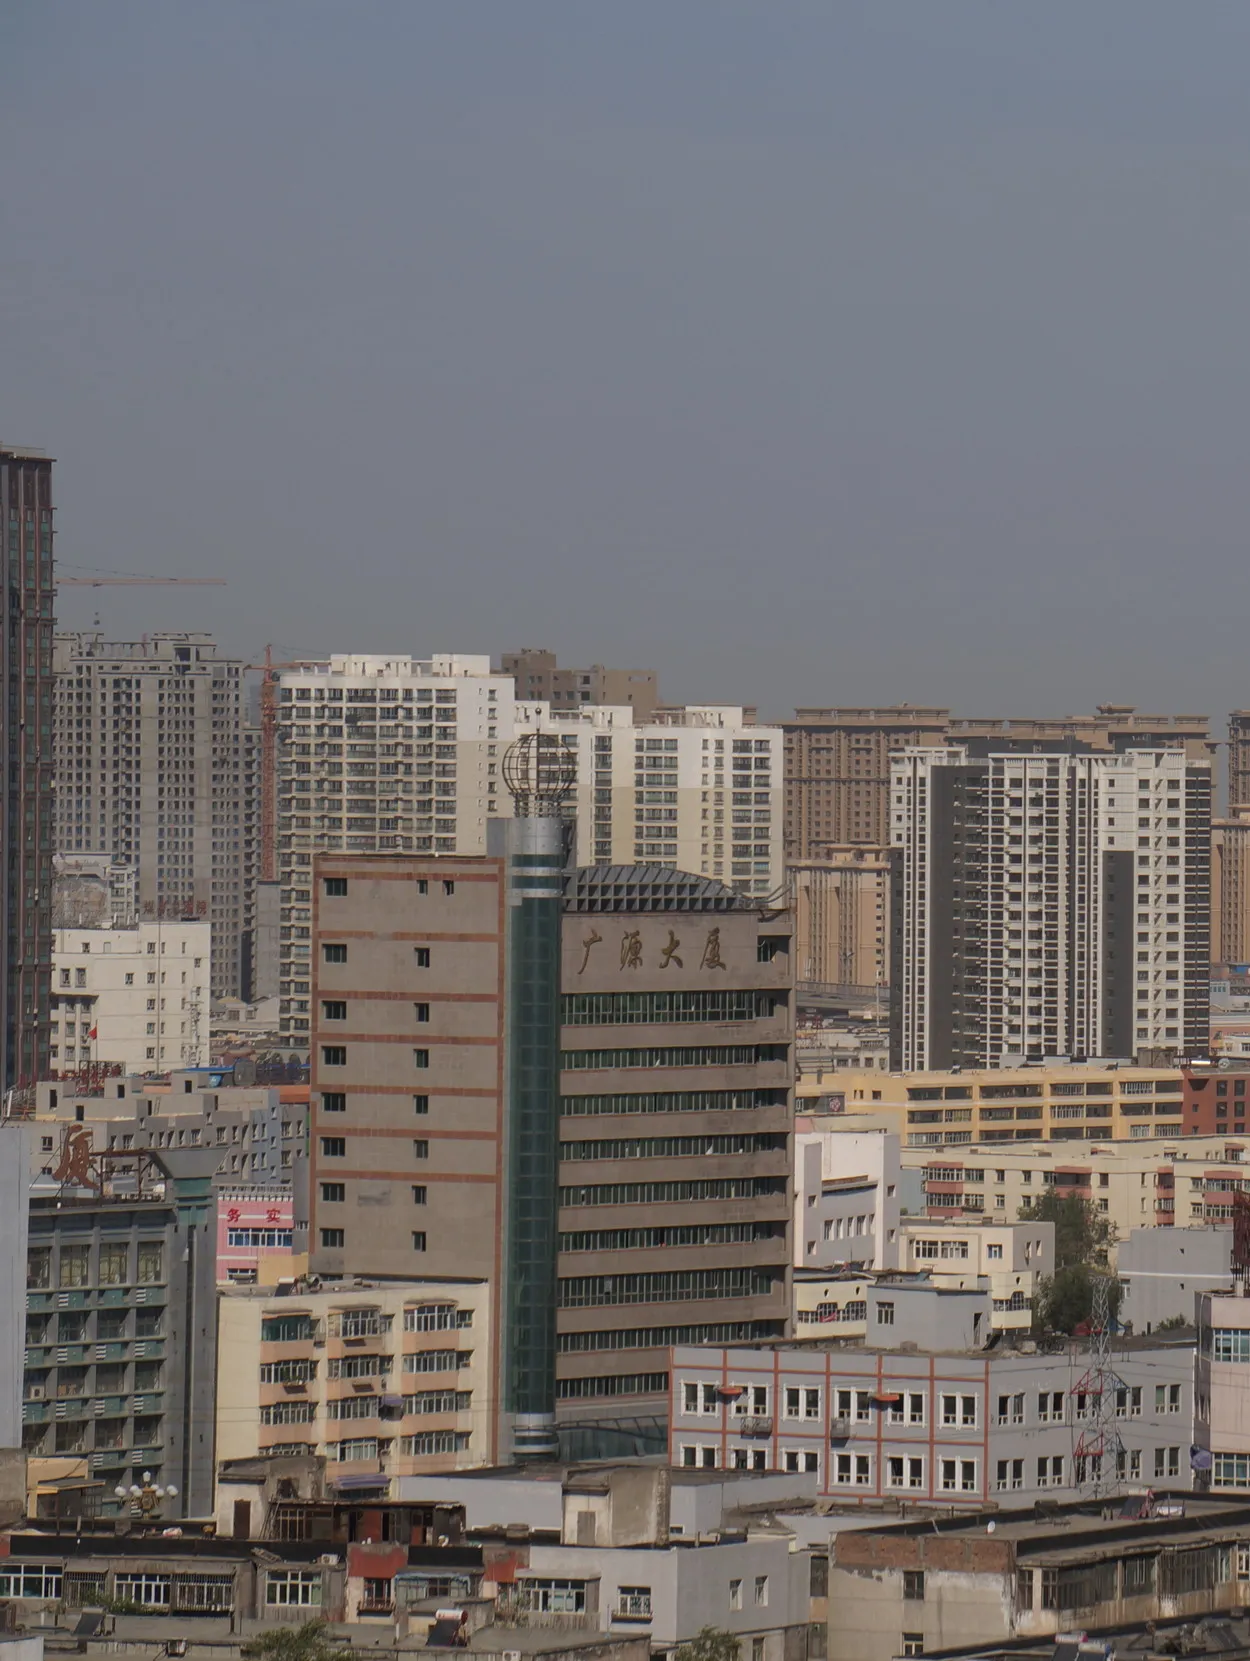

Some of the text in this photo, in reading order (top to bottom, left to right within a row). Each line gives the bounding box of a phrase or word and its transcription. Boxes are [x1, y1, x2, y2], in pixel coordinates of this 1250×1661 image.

[577, 926, 727, 975] 广源大厦
[52, 1124, 100, 1190] 厦
[227, 1208, 281, 1223] 务实
